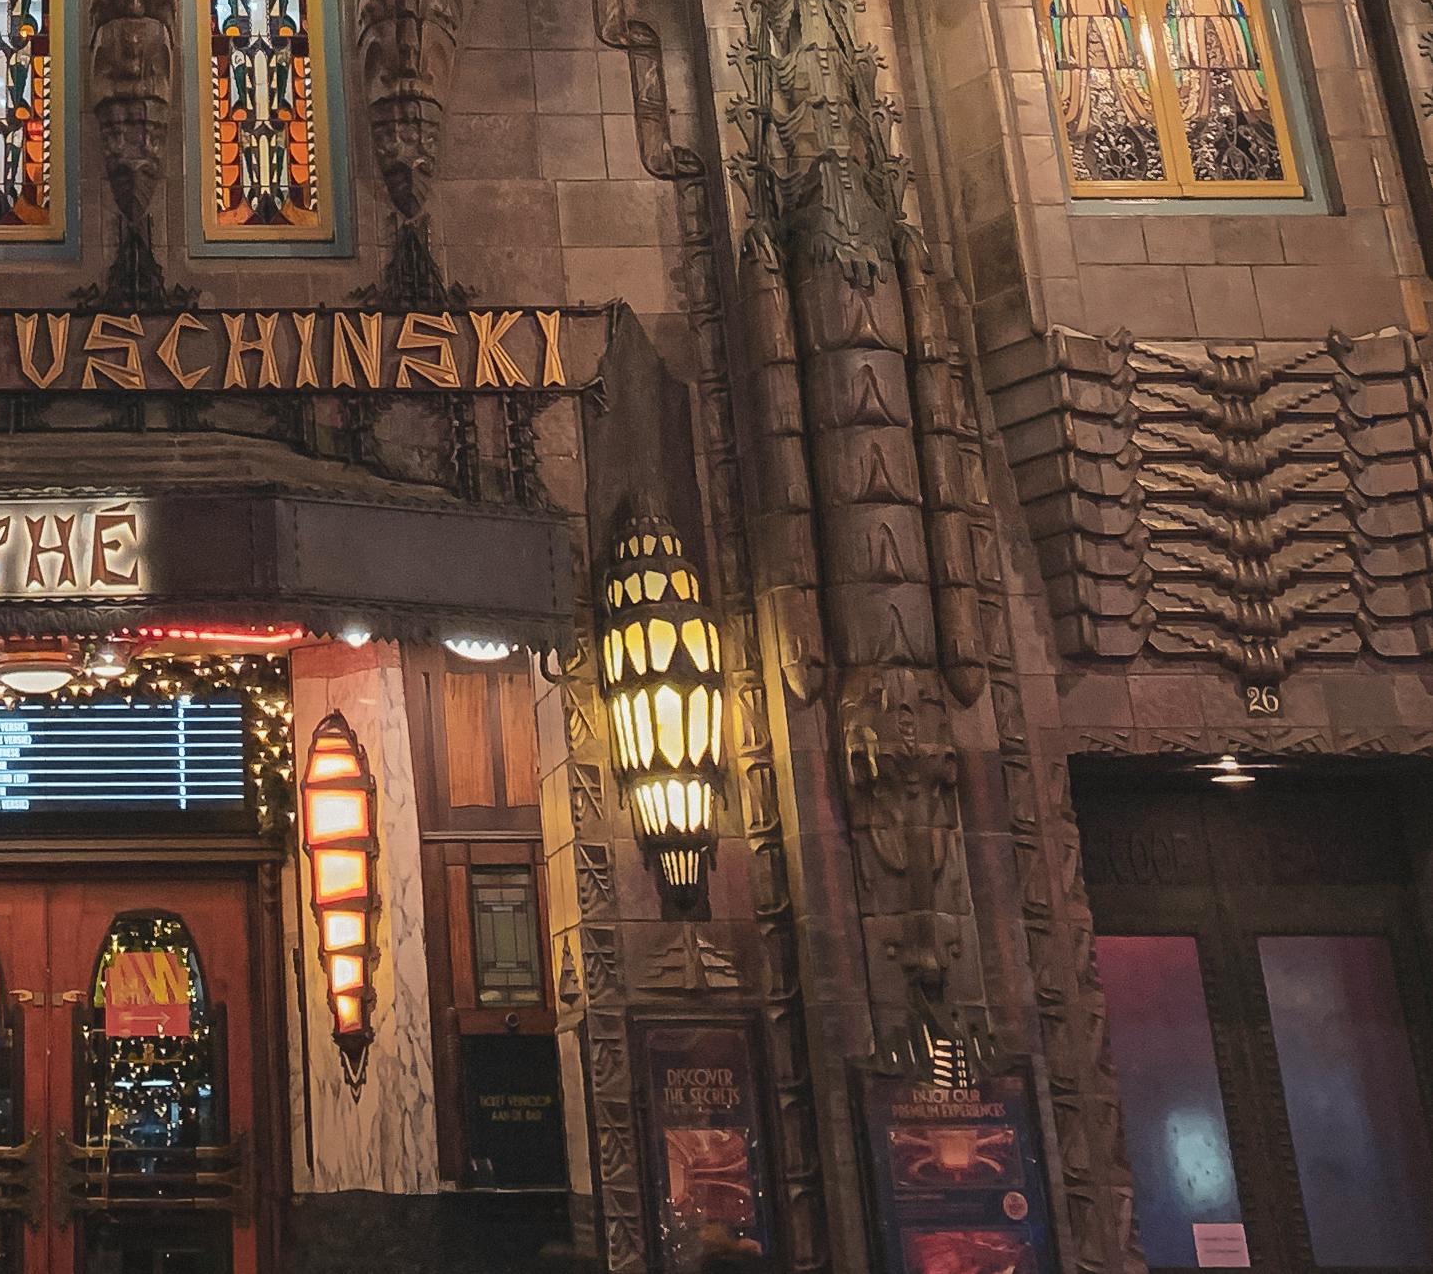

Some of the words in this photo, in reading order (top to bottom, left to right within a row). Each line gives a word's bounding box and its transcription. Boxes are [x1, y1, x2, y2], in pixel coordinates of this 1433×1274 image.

[1247, 686, 1279, 714] 26
[667, 1067, 733, 1086] DISCOVER
[663, 1088, 686, 1105] THE
[690, 1087, 740, 1105] SECRETS
